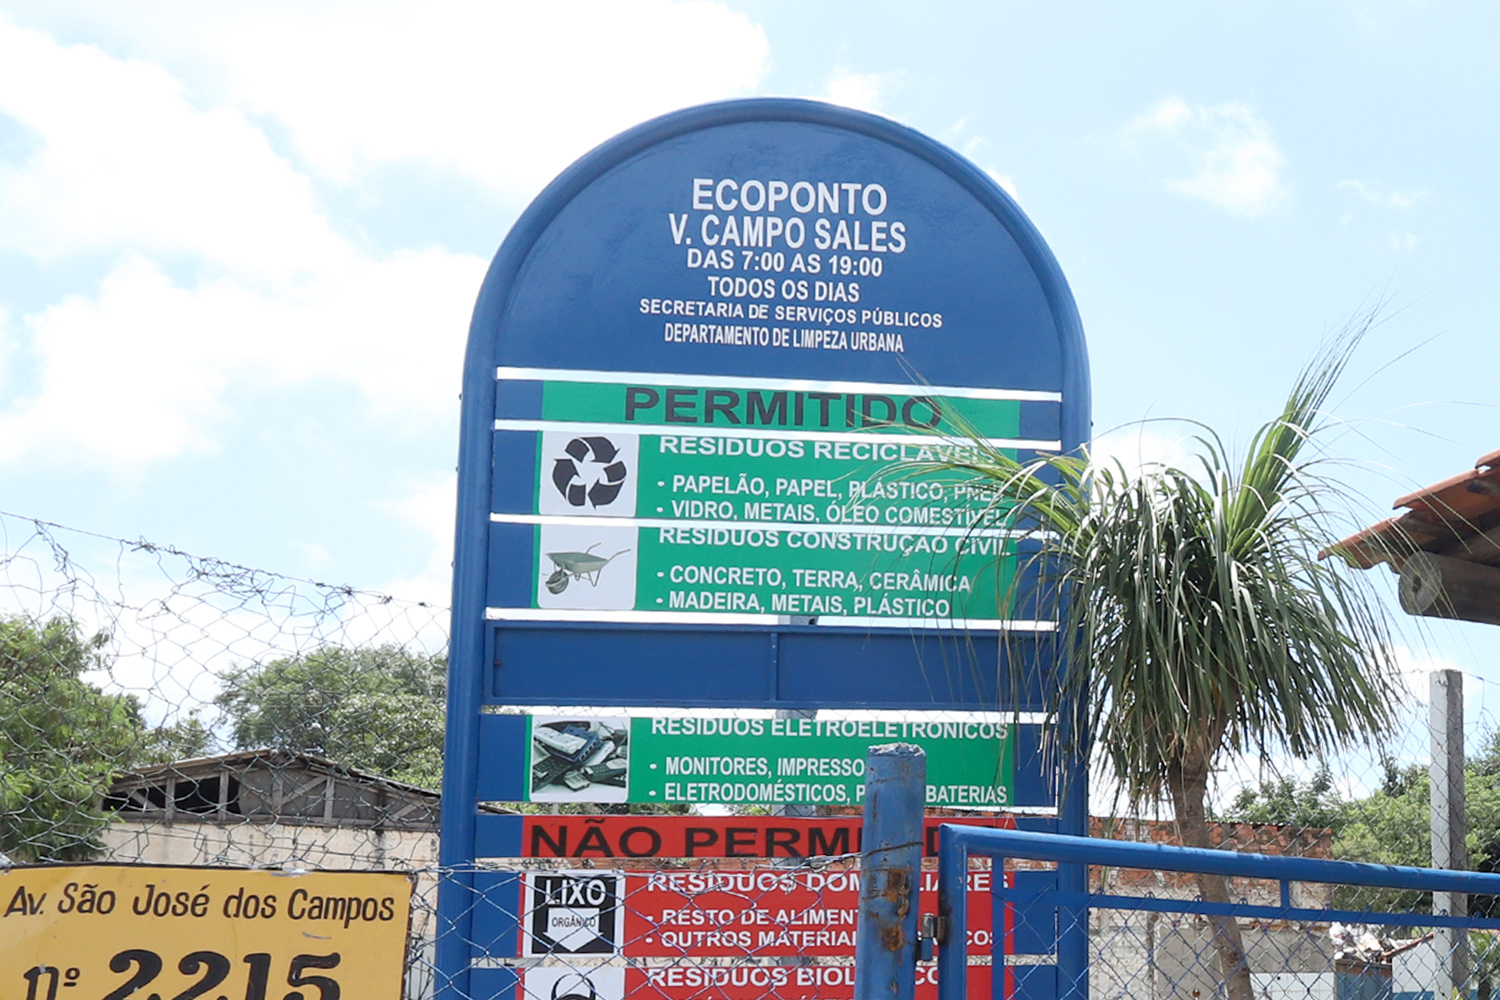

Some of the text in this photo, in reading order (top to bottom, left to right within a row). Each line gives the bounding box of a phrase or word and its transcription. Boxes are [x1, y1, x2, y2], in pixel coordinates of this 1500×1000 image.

[693, 178, 887, 215] ECOPONTO
[669, 213, 906, 253] V. CAMPO SALES
[687, 249, 882, 277] DAS 7:00 AS 19:00
[708, 276, 860, 303] TODOS OS DIAS
[640, 299, 942, 328] SECRETARIA DE SERVIÇOS PÚBLICOS
[665, 323, 904, 352] DEPARTAMENTO DE LIMPEZA URBANA
[625, 387, 942, 430] PERMITIDO
[659, 436, 805, 459] RESIDUOS
[672, 473, 769, 497] PAPELÃO,
[776, 479, 843, 500] PAPEL,
[849, 477, 948, 504] PLÁSTICO,
[671, 500, 1007, 527] VIDRO, METAIS, ÓLEO COMESTÍVEL
[659, 527, 779, 547] RESIDUOS
[954, 537, 1011, 556] CIVIL
[669, 565, 971, 593] CONCRETO, TERRA, CERÂMICA
[668, 590, 950, 617] MADEIRA, METAIS, PLÁSTICO
[651, 717, 764, 736] RESIDUOS
[665, 756, 865, 778] MONITORES, IMPRESSO
[664, 779, 851, 805] ELETRODOMÉSTICOS,
[925, 785, 1007, 804] BATERIAS
[530, 818, 662, 857] NÃO
[545, 879, 606, 906] LIXO
[647, 872, 795, 892] RESIDUOS
[3, 882, 395, 929] Av. São José dos Campos
[662, 909, 739, 925] RESTO
[741, 909, 769, 924] DE
[661, 931, 751, 948] OUTROS
[648, 968, 788, 987] RESIDUOS
